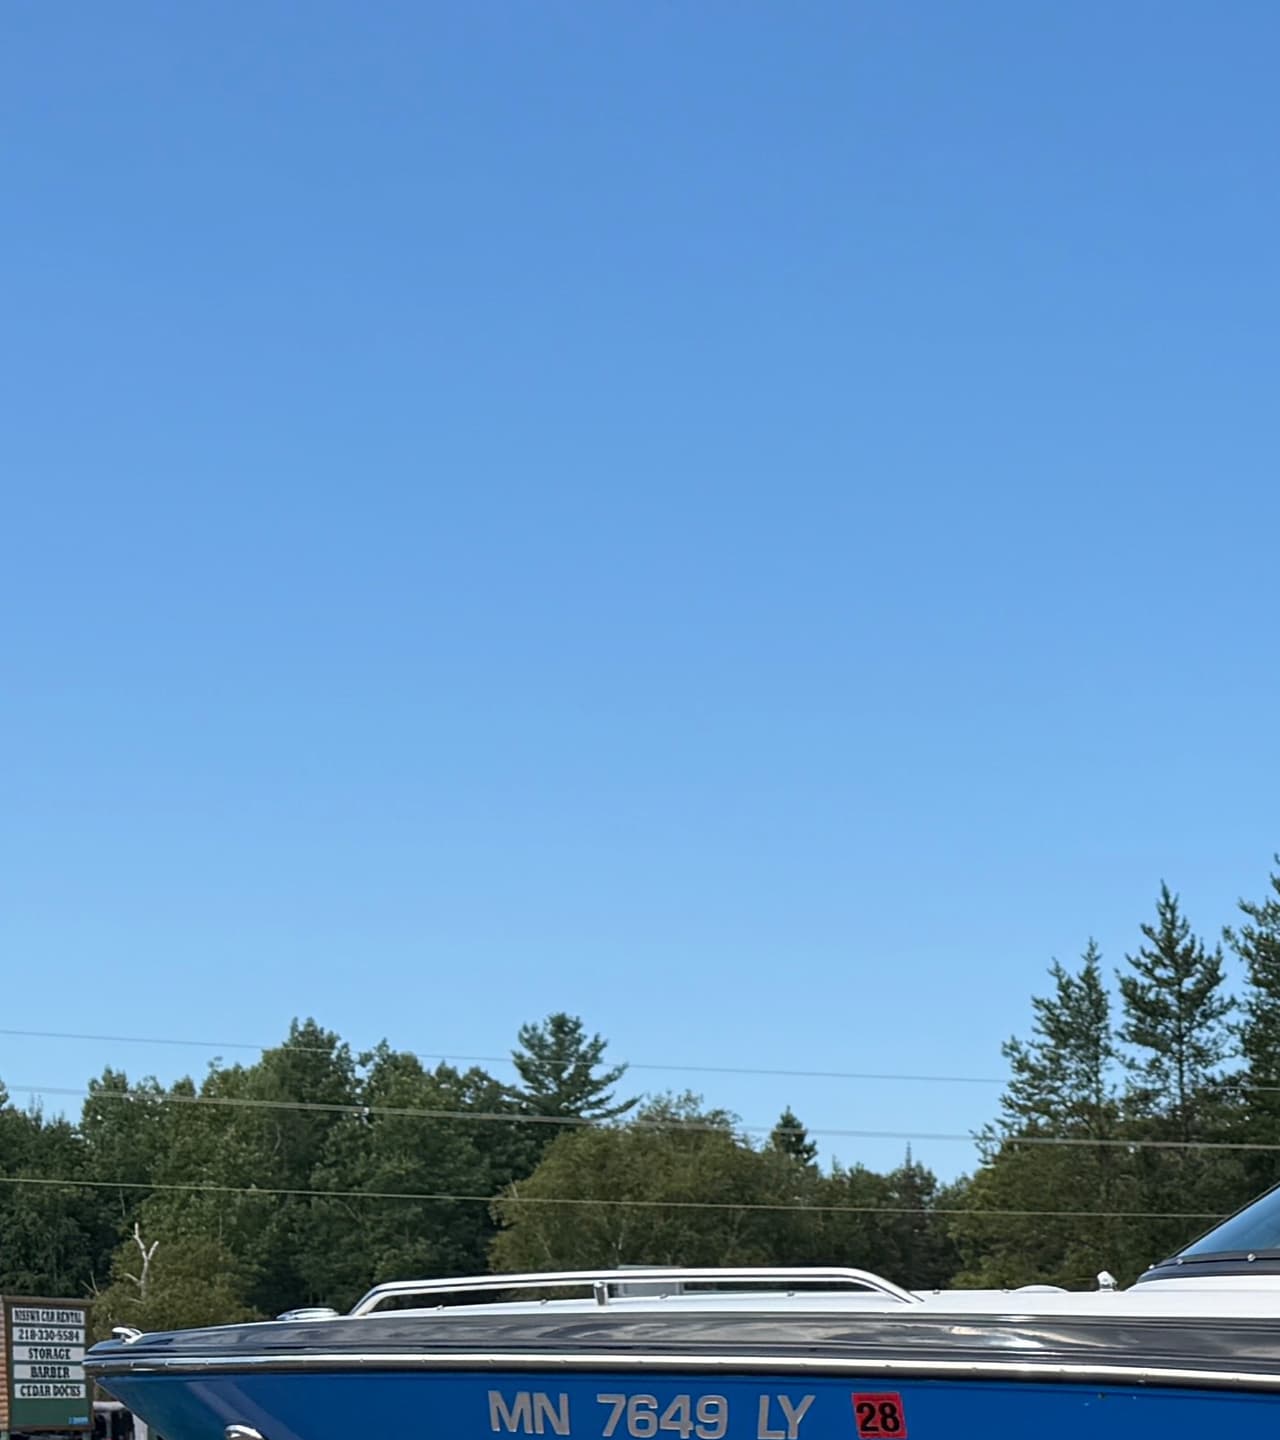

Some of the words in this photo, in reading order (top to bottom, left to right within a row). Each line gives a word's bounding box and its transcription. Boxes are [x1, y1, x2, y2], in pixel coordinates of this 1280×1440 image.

[18, 1328, 80, 1341] 218-330-5584
[28, 1348, 71, 1360] STORAGE
[30, 1366, 70, 1378] BARBER
[20, 1385, 51, 1397] CEDAR
[52, 1385, 81, 1397] DOCKS
[487, 1390, 571, 1436] MN
[596, 1393, 729, 1440] 7649
[756, 1394, 816, 1440] LY
[856, 1402, 900, 1432] 28
